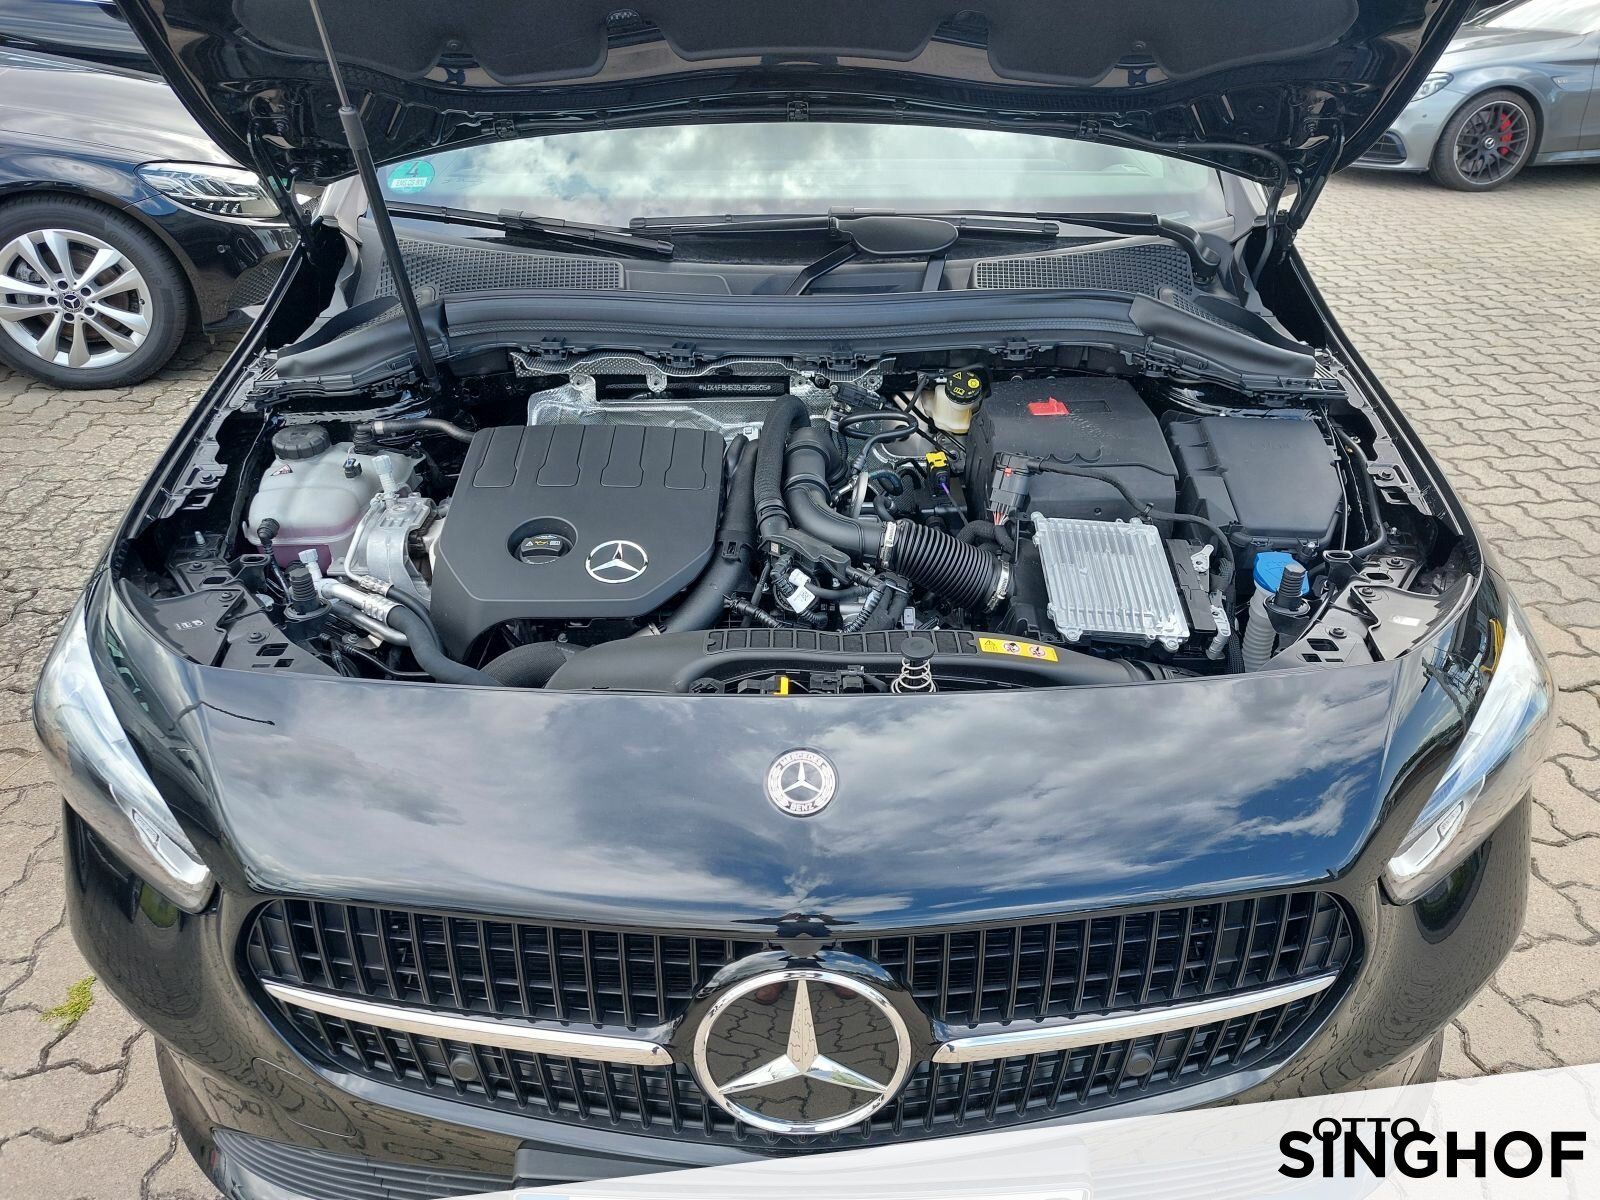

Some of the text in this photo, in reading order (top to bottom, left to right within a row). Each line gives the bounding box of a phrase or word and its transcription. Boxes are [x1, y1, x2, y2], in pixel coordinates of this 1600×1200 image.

[406, 161, 419, 177] 4
[780, 752, 823, 767] MERCEDES
[789, 801, 815, 812] BENZ
